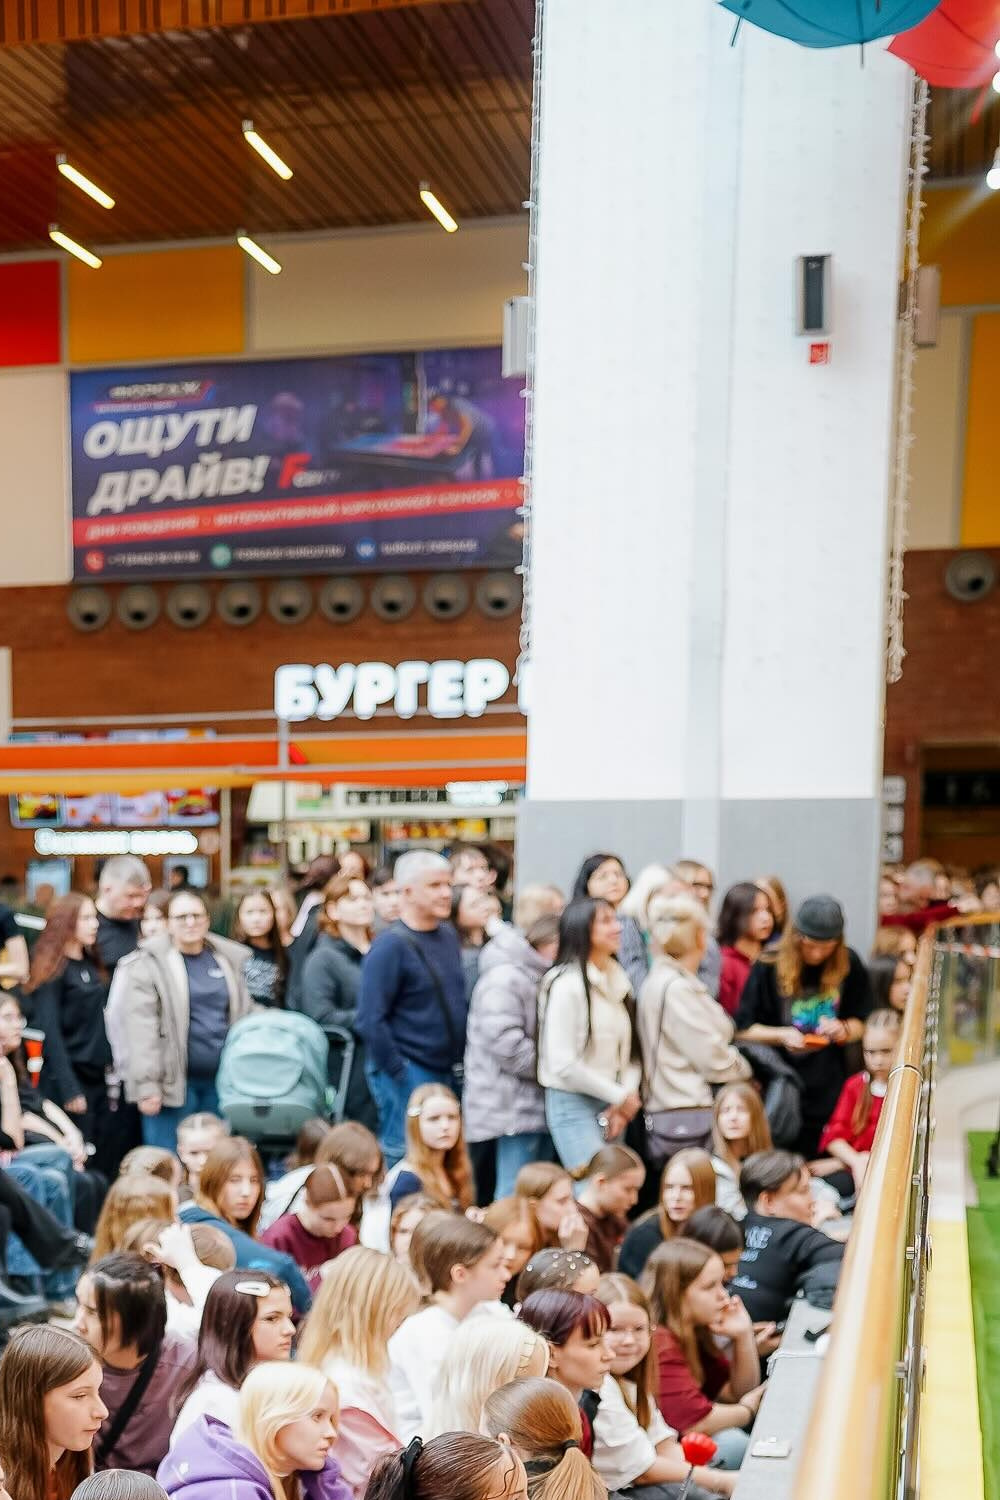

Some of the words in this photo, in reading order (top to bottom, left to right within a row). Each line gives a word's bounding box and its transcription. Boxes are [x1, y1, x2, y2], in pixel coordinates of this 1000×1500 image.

[83, 404, 258, 459] ОЩУТИ
[86, 452, 271, 516] ДРАЙВ!
[274, 659, 509, 721] БУРГЕР
